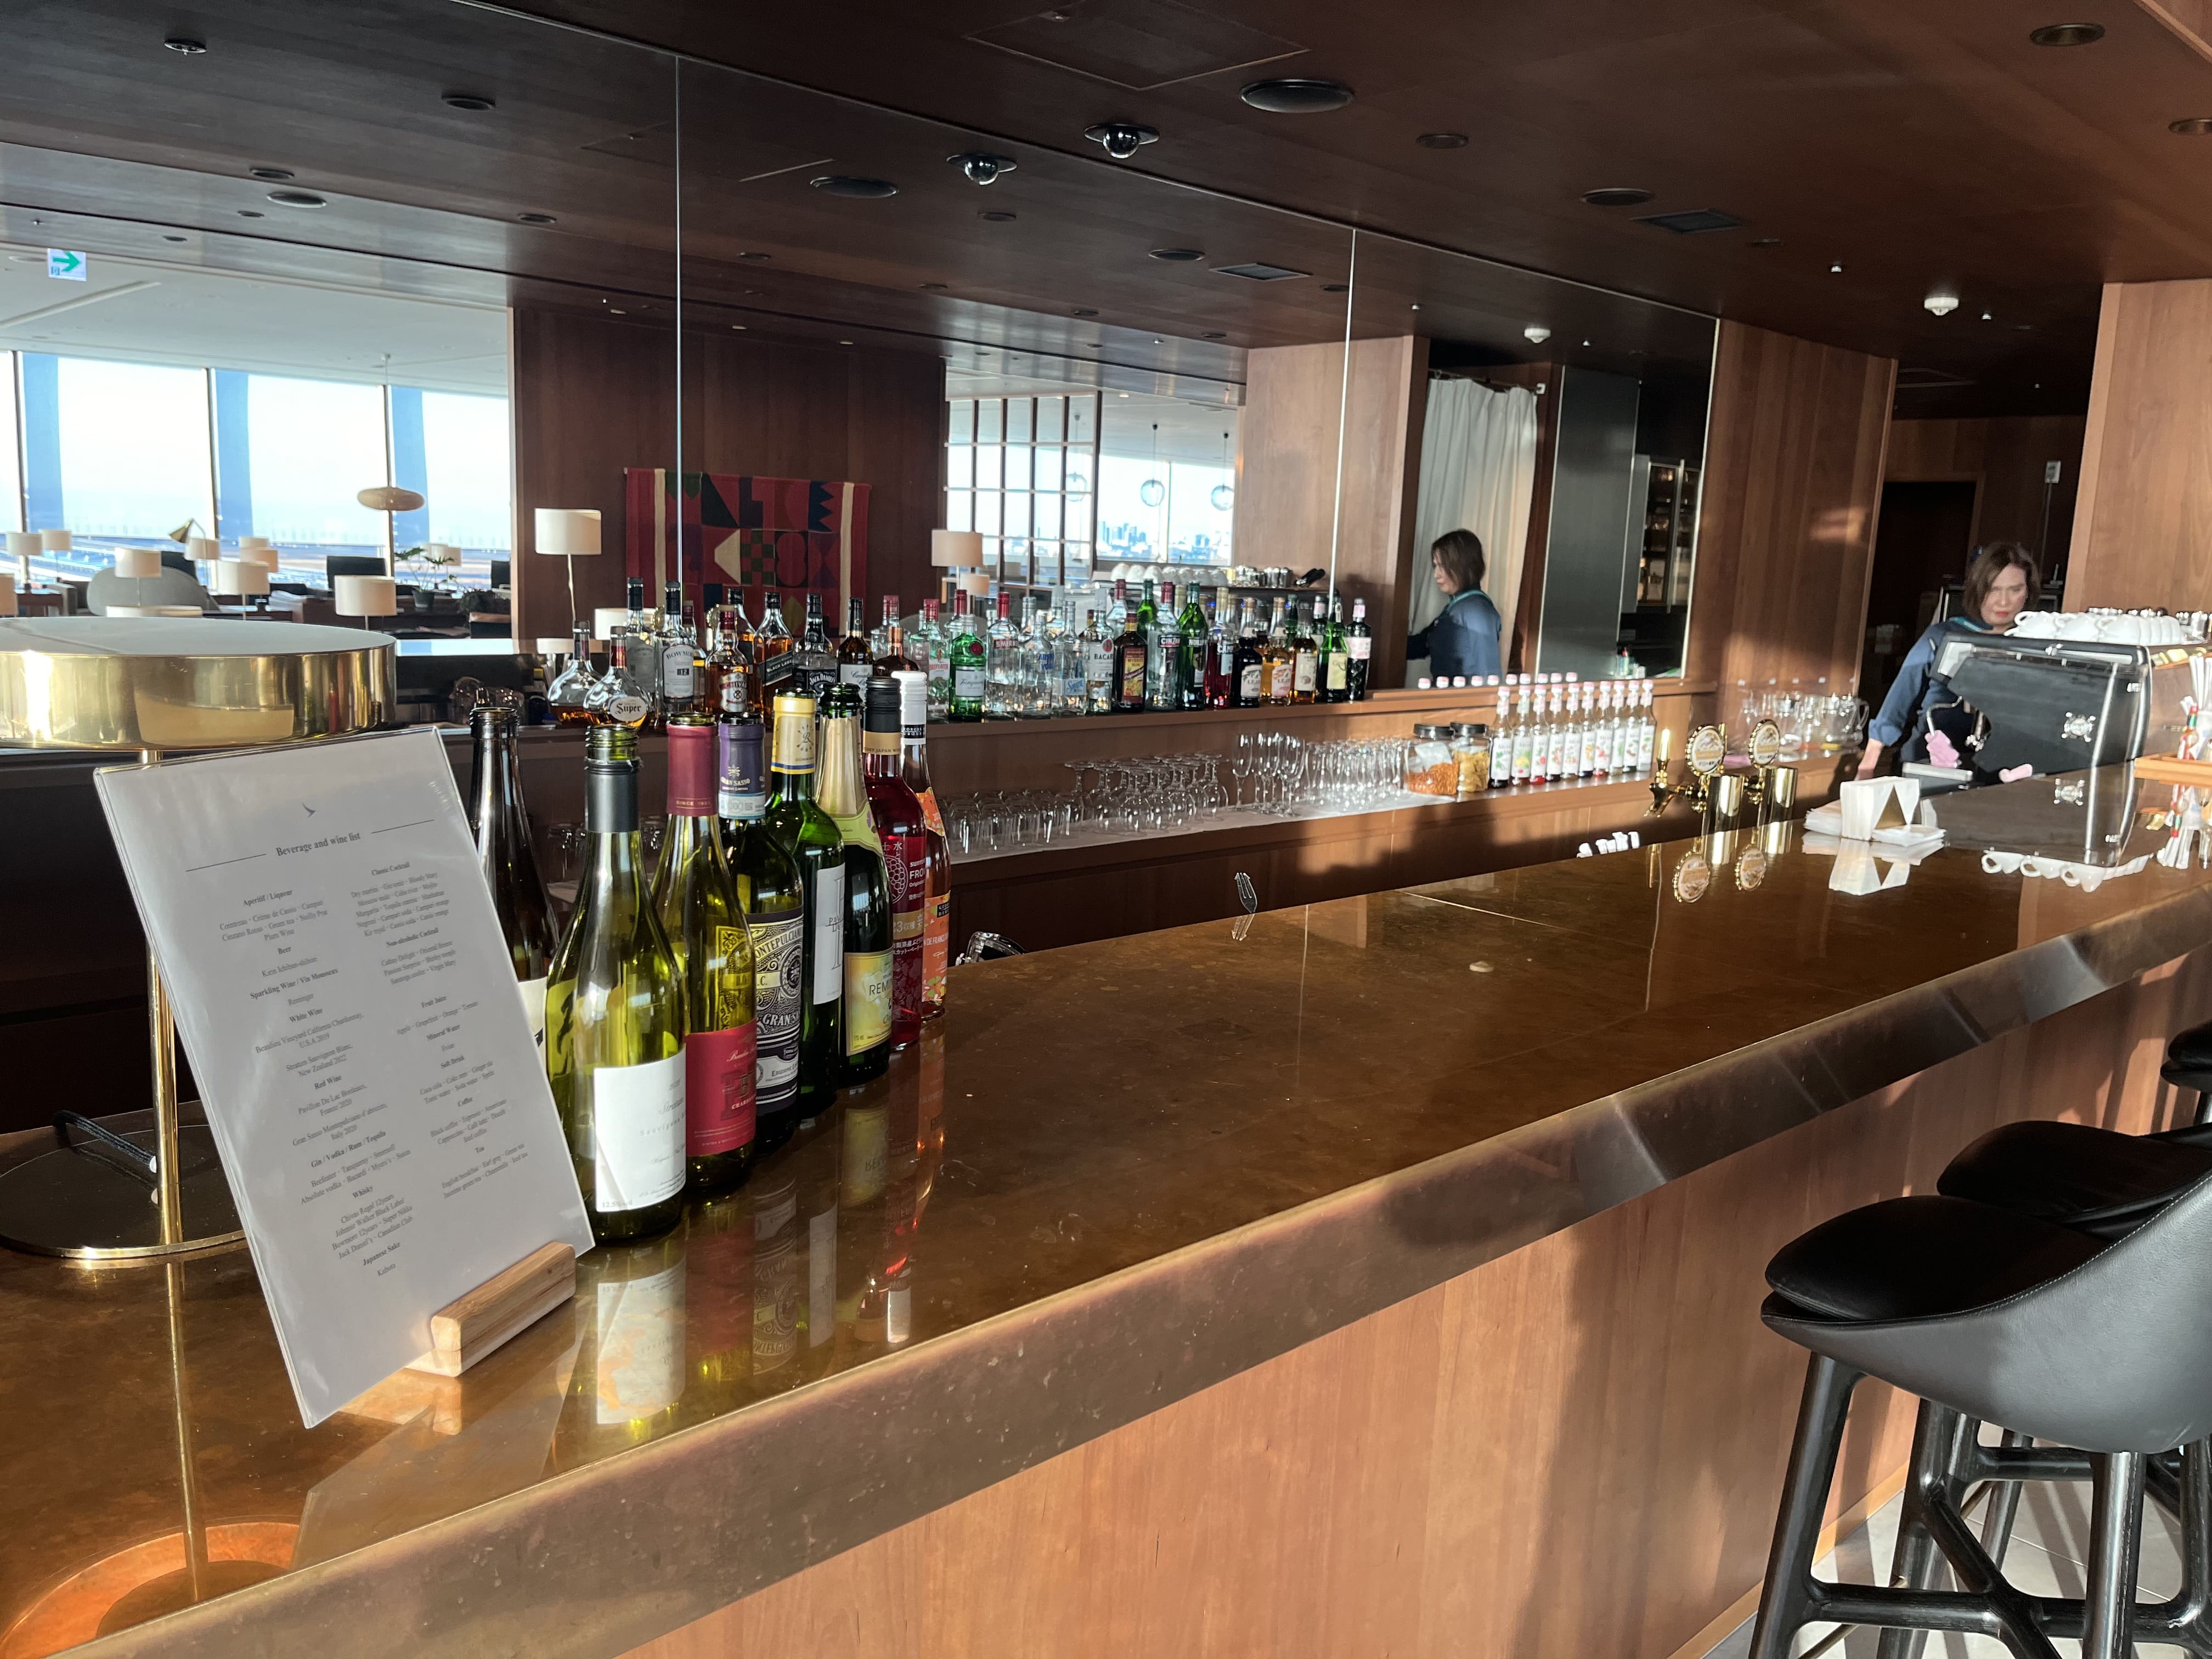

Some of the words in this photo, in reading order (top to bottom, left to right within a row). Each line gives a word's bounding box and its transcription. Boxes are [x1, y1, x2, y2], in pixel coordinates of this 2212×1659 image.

[615, 703, 641, 715] Super
[720, 777, 733, 786] GRAN
[733, 777, 751, 786] SASSO
[276, 844, 312, 856] Beverage
[314, 838, 329, 848] and
[330, 836, 348, 844] wine
[348, 833, 360, 841] list
[244, 895, 266, 906] Aperitif
[269, 890, 292, 899] Liqueur
[250, 986, 280, 1000] Sparkling
[290, 1014, 307, 1022] White
[314, 1080, 326, 1090] Red
[326, 1150, 345, 1160] Vodka
[348, 1142, 362, 1150] Rum
[352, 1187, 373, 1198] Whisky
[364, 1250, 386, 1266] Japanese
[387, 1243, 400, 1252] Sake
